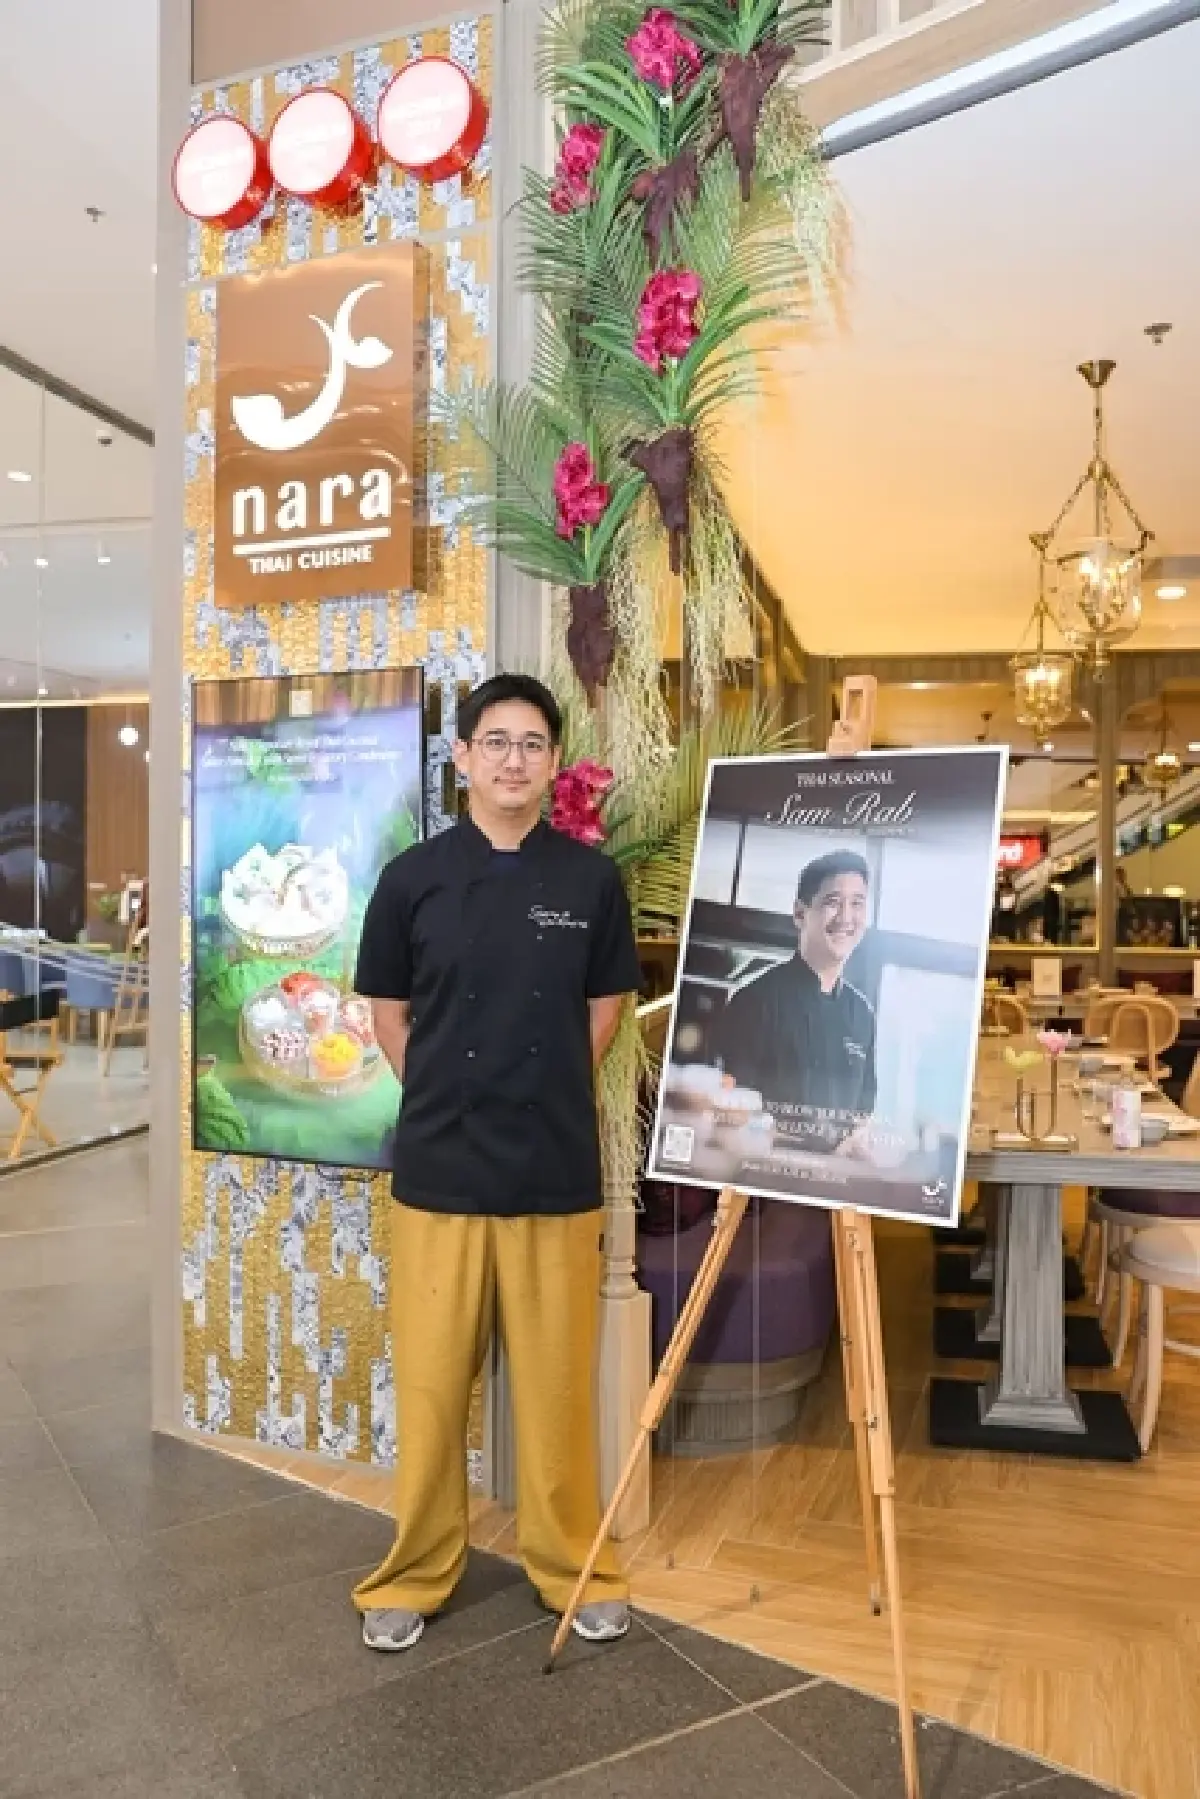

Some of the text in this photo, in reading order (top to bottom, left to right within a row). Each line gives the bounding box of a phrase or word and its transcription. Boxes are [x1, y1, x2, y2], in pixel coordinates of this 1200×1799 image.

[232, 468, 392, 538] nara
[247, 544, 374, 575] THAI CUISINE
[796, 769, 895, 788] THAI SEASONAL
[764, 789, 918, 825] Sam Rab
